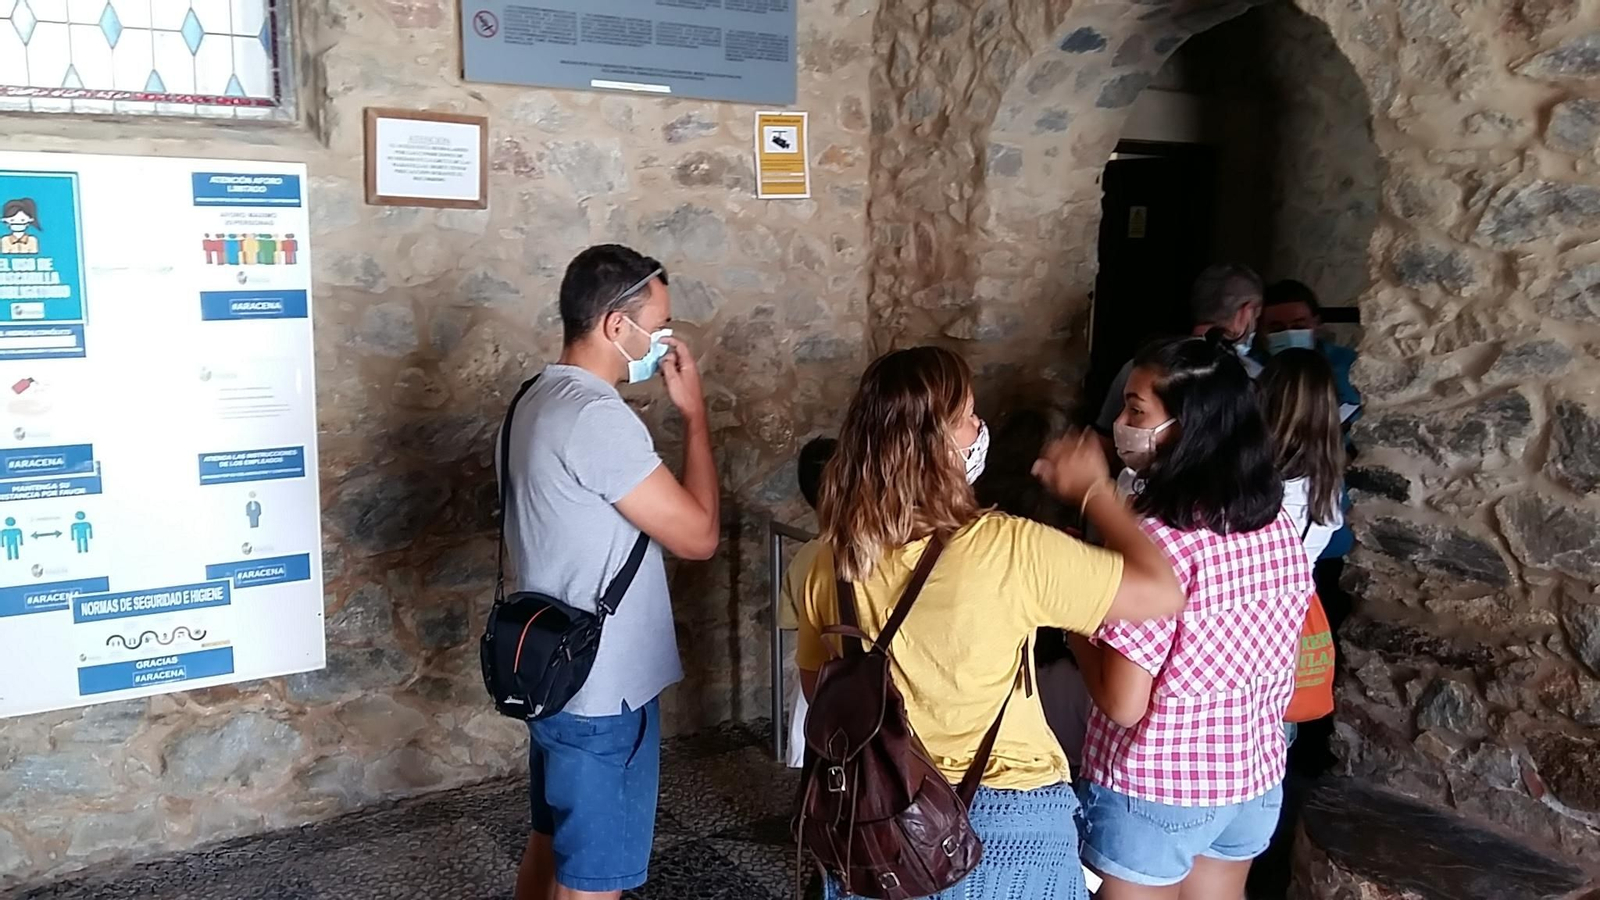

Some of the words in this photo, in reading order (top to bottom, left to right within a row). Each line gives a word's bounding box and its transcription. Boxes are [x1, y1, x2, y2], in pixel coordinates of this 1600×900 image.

[8, 457, 65, 470] #ARACENA
[41, 489, 58, 498] POR
[237, 567, 285, 579] #ARACENA
[81, 599, 119, 616] NORMAS
[120, 598, 133, 612] DE
[133, 591, 183, 610] SEGURIDAD
[182, 590, 190, 601] E
[190, 586, 225, 602] HIGIENE
[136, 656, 178, 669] GRACIAS
[135, 669, 185, 683] #ARACENA
